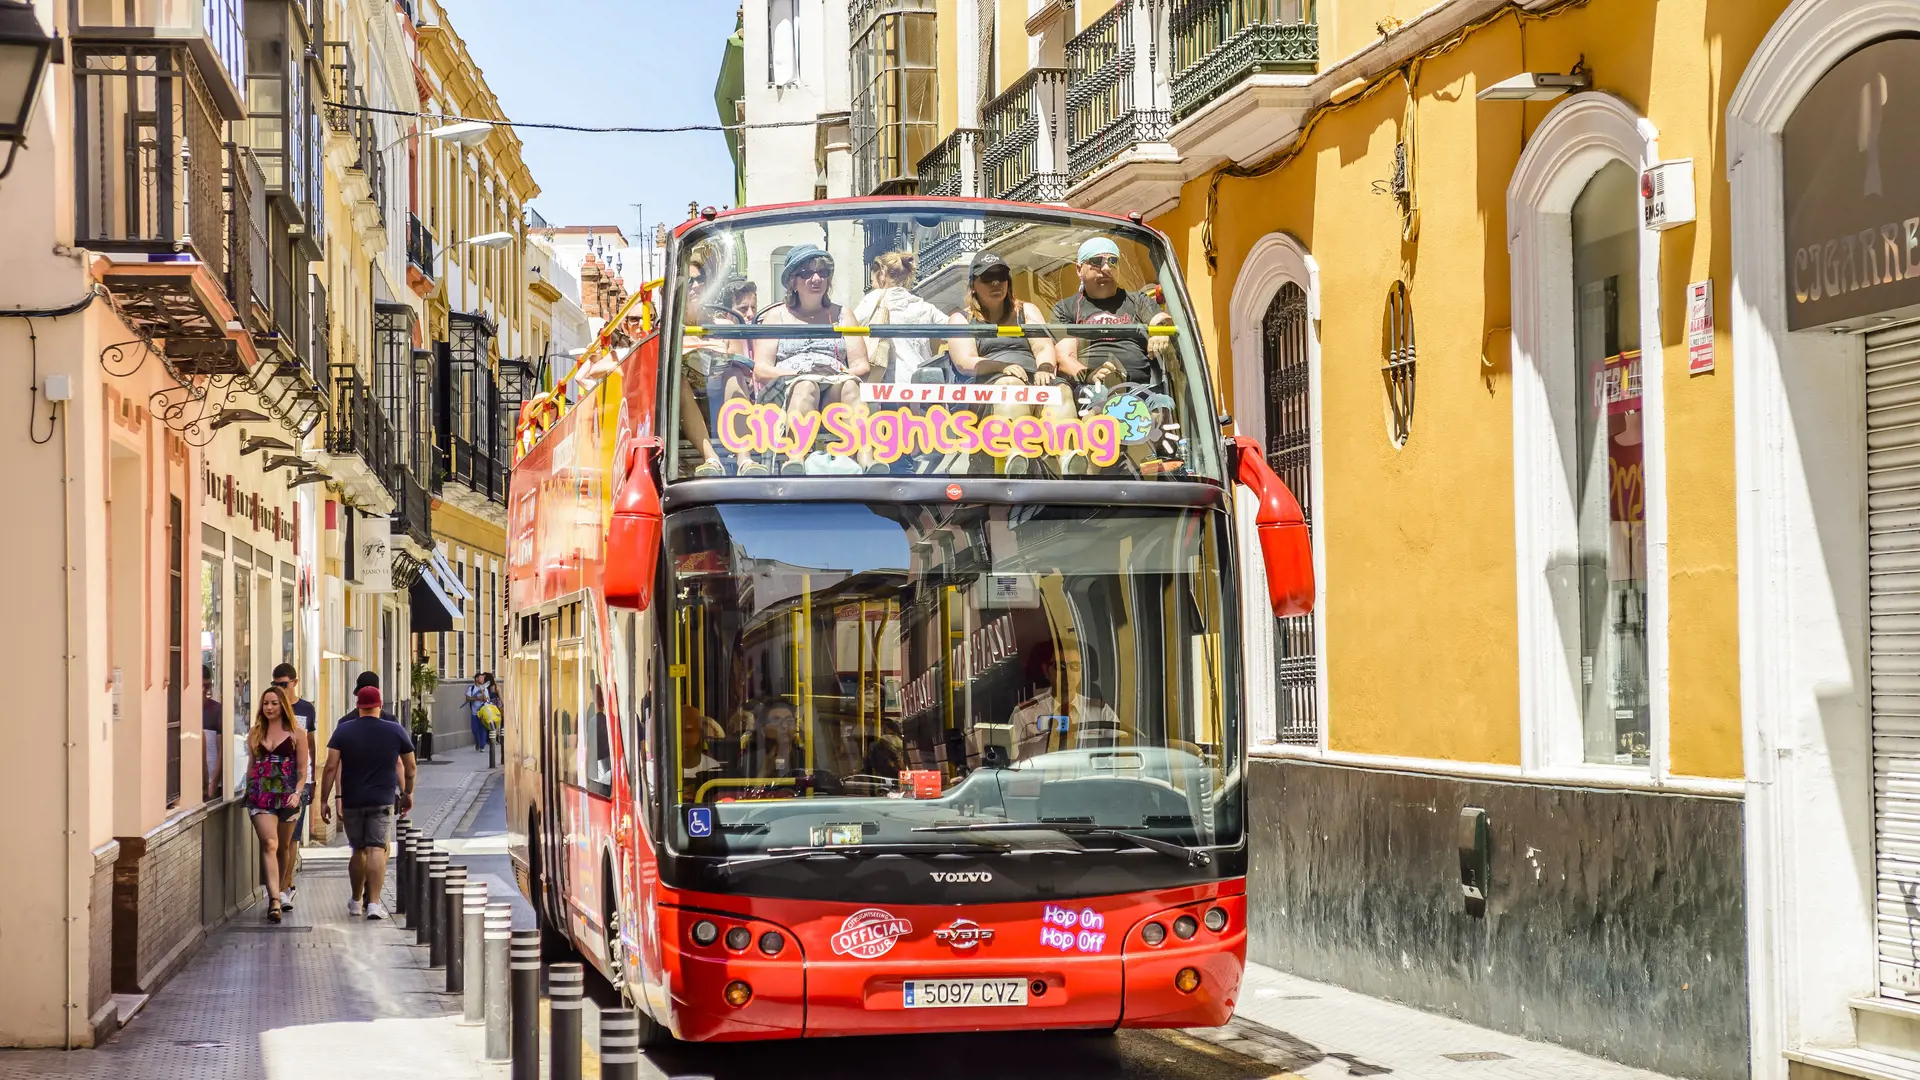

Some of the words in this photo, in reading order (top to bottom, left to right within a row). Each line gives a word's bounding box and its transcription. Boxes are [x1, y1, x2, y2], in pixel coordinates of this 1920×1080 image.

[871, 384, 1050, 403] Worldwide
[717, 397, 821, 456] City
[821, 402, 1121, 467] Sightseeing
[930, 872, 993, 883] VOLVO
[1043, 905, 1078, 929] Hop
[1081, 909, 1104, 929] On
[839, 921, 908, 950] OFFICIAL
[862, 938, 893, 955] TOUR
[1040, 927, 1075, 952] Hop
[1078, 931, 1106, 952] Off
[924, 983, 974, 1004] 5097
[981, 982, 1019, 1003] CVZ
